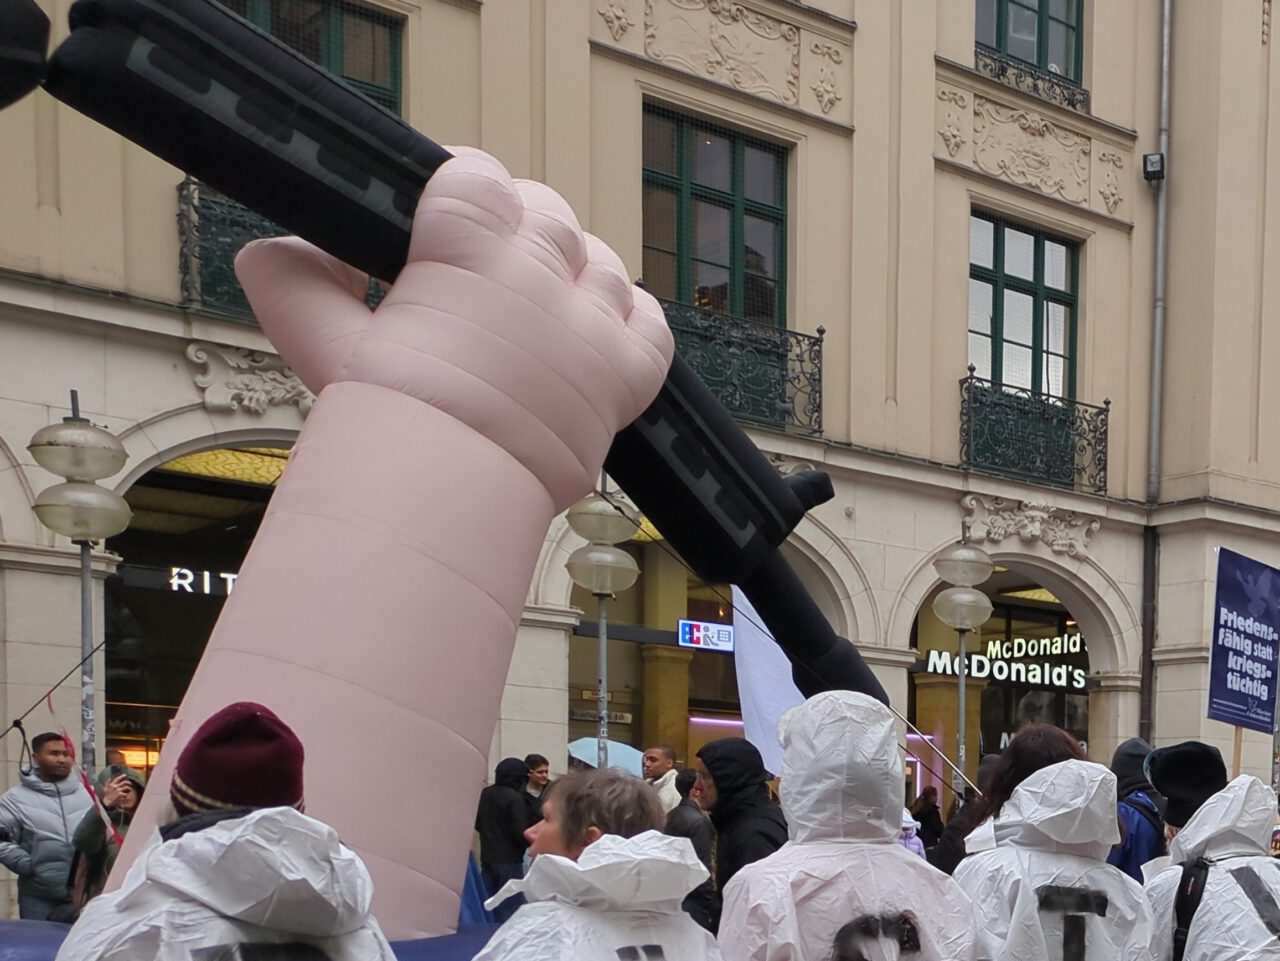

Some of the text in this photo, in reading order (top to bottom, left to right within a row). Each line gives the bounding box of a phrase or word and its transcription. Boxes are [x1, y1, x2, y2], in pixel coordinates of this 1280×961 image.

[1219, 607, 1278, 641] Friedens-
[1218, 627, 1273, 662] fähig statt
[927, 650, 1086, 688] McDonald's
[1227, 651, 1272, 679] kriegs-
[1227, 672, 1269, 701] tüchtig
